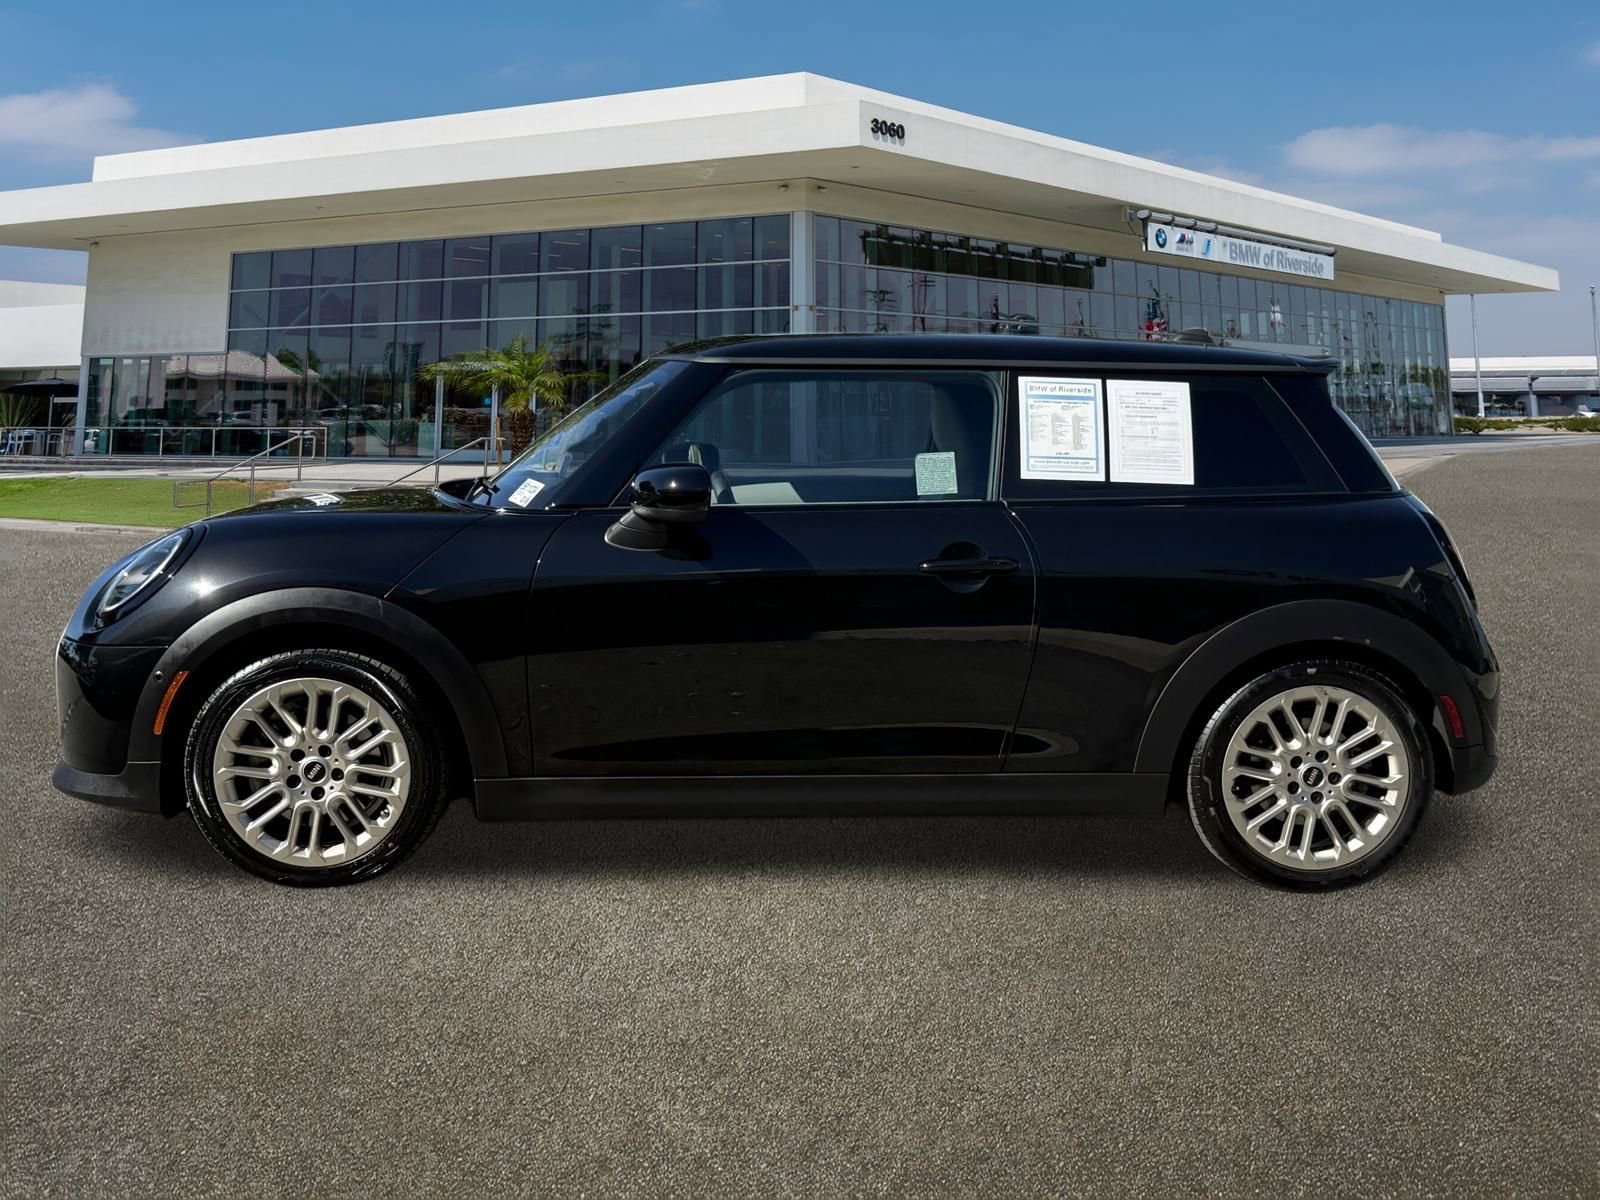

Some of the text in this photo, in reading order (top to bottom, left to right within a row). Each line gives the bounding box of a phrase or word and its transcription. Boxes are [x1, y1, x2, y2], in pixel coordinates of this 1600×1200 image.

[871, 118, 905, 139] 3060
[1229, 241, 1260, 265] BMW
[1263, 249, 1275, 267] of
[1276, 250, 1324, 275] Riverside
[1029, 384, 1048, 392] BMW
[307, 763, 322, 780] MINI
[1306, 768, 1319, 785] MINI
